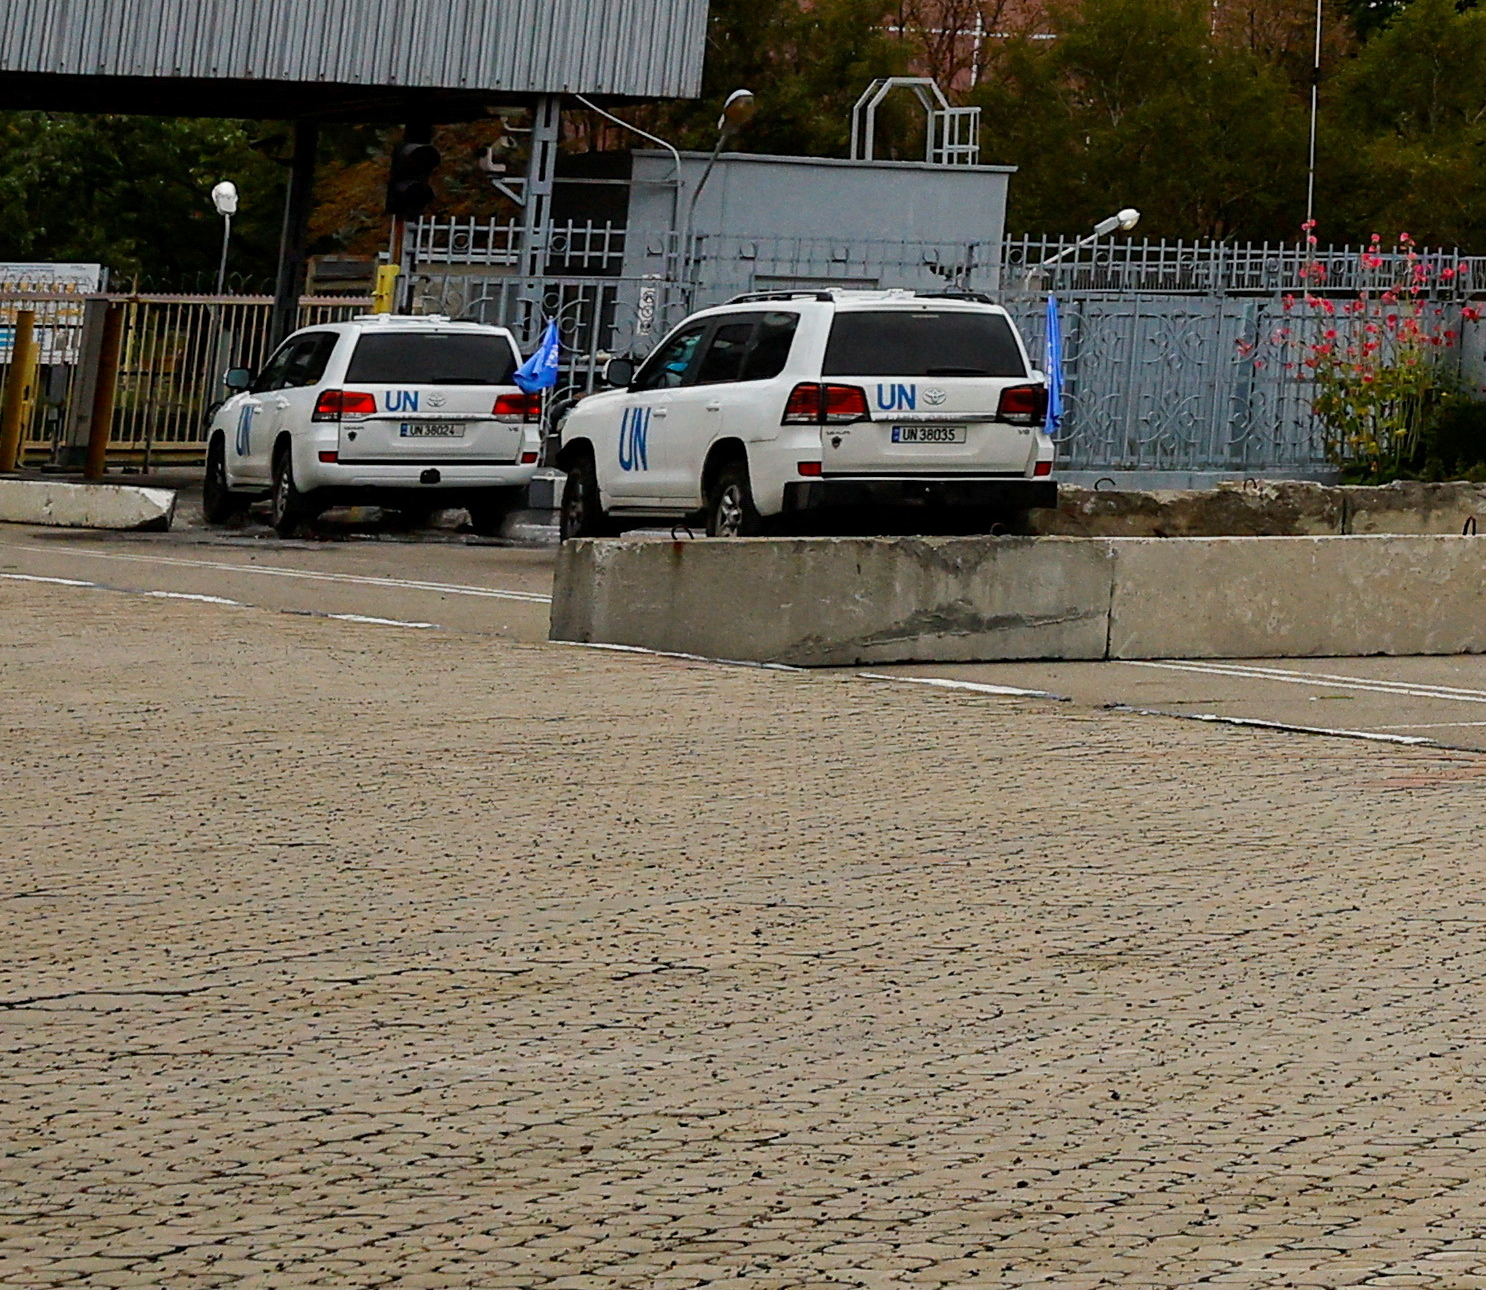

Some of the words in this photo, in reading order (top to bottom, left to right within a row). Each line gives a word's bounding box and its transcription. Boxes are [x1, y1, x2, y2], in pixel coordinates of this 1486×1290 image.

[385, 390, 419, 412] UN
[876, 384, 916, 411] UN
[410, 424, 423, 435] UN
[619, 406, 651, 472] UN
[903, 427, 917, 440] UN
[919, 427, 956, 441] 38035
